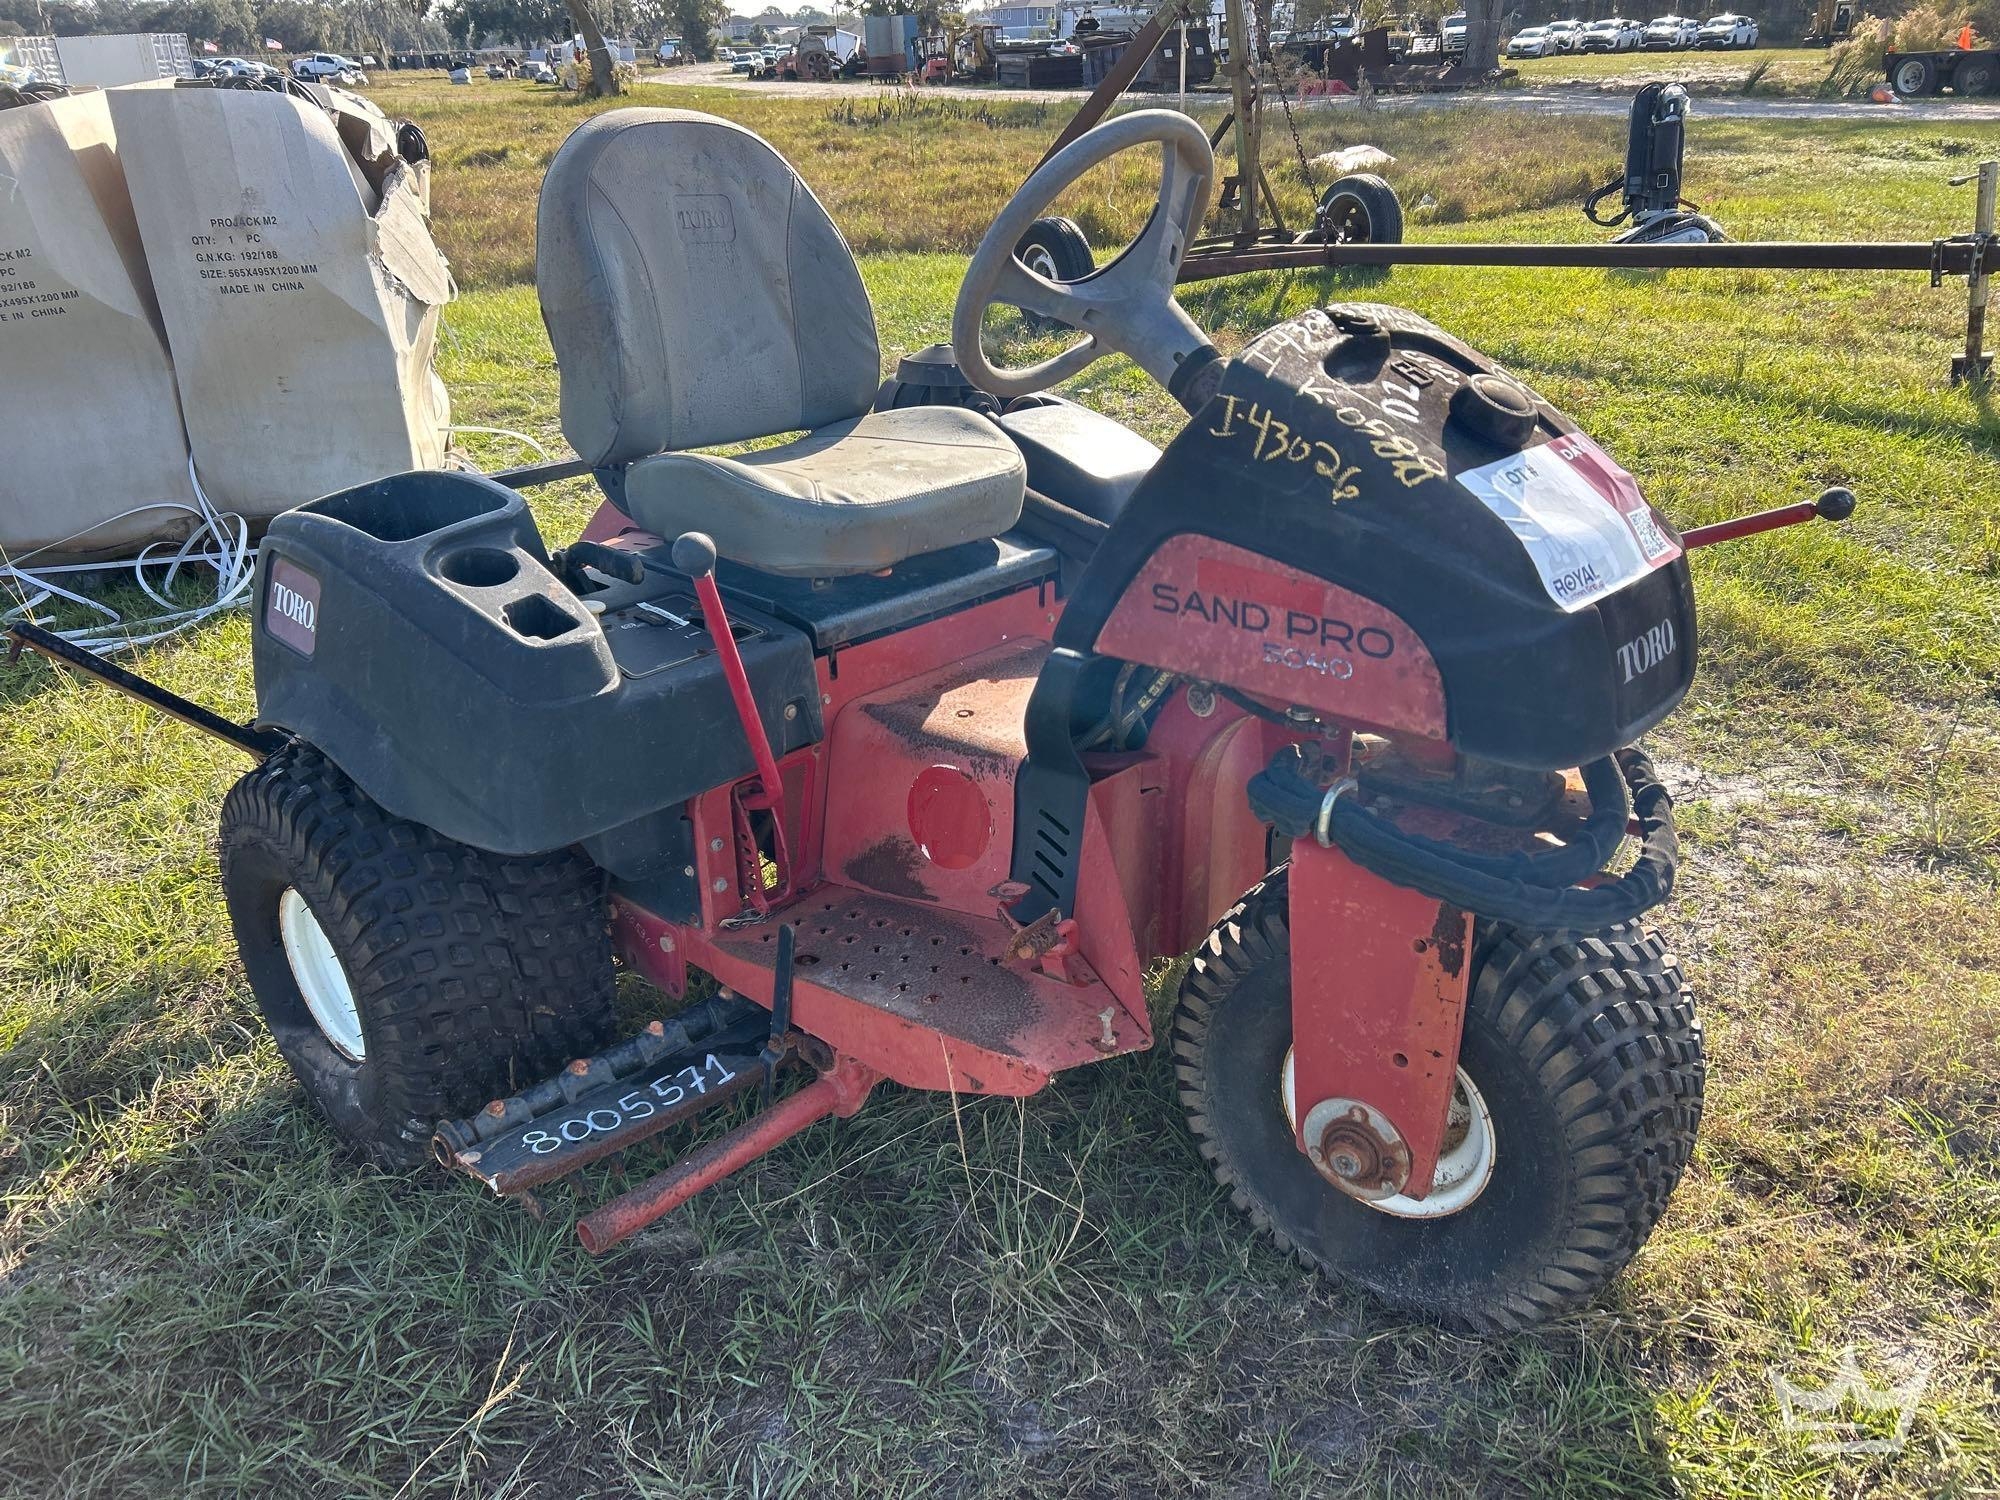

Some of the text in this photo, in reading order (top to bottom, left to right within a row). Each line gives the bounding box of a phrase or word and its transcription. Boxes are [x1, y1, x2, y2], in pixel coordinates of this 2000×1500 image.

[210, 216, 278, 228] PROJACK M2
[191, 233, 261, 246] QTY: 1 PC
[15, 248, 32, 259] M2
[195, 250, 278, 263] G.N.KG: 192/188
[200, 264, 318, 279] SIZE: 565X495X1200 MM
[219, 281, 305, 295] MADE IN CHINA
[61, 290, 80, 300] MM
[12, 311, 24, 320] IN
[31, 306, 67, 318] CHINA
[1152, 583, 1395, 659] SAND PRO
[521, 1053, 736, 1154] 8005571
